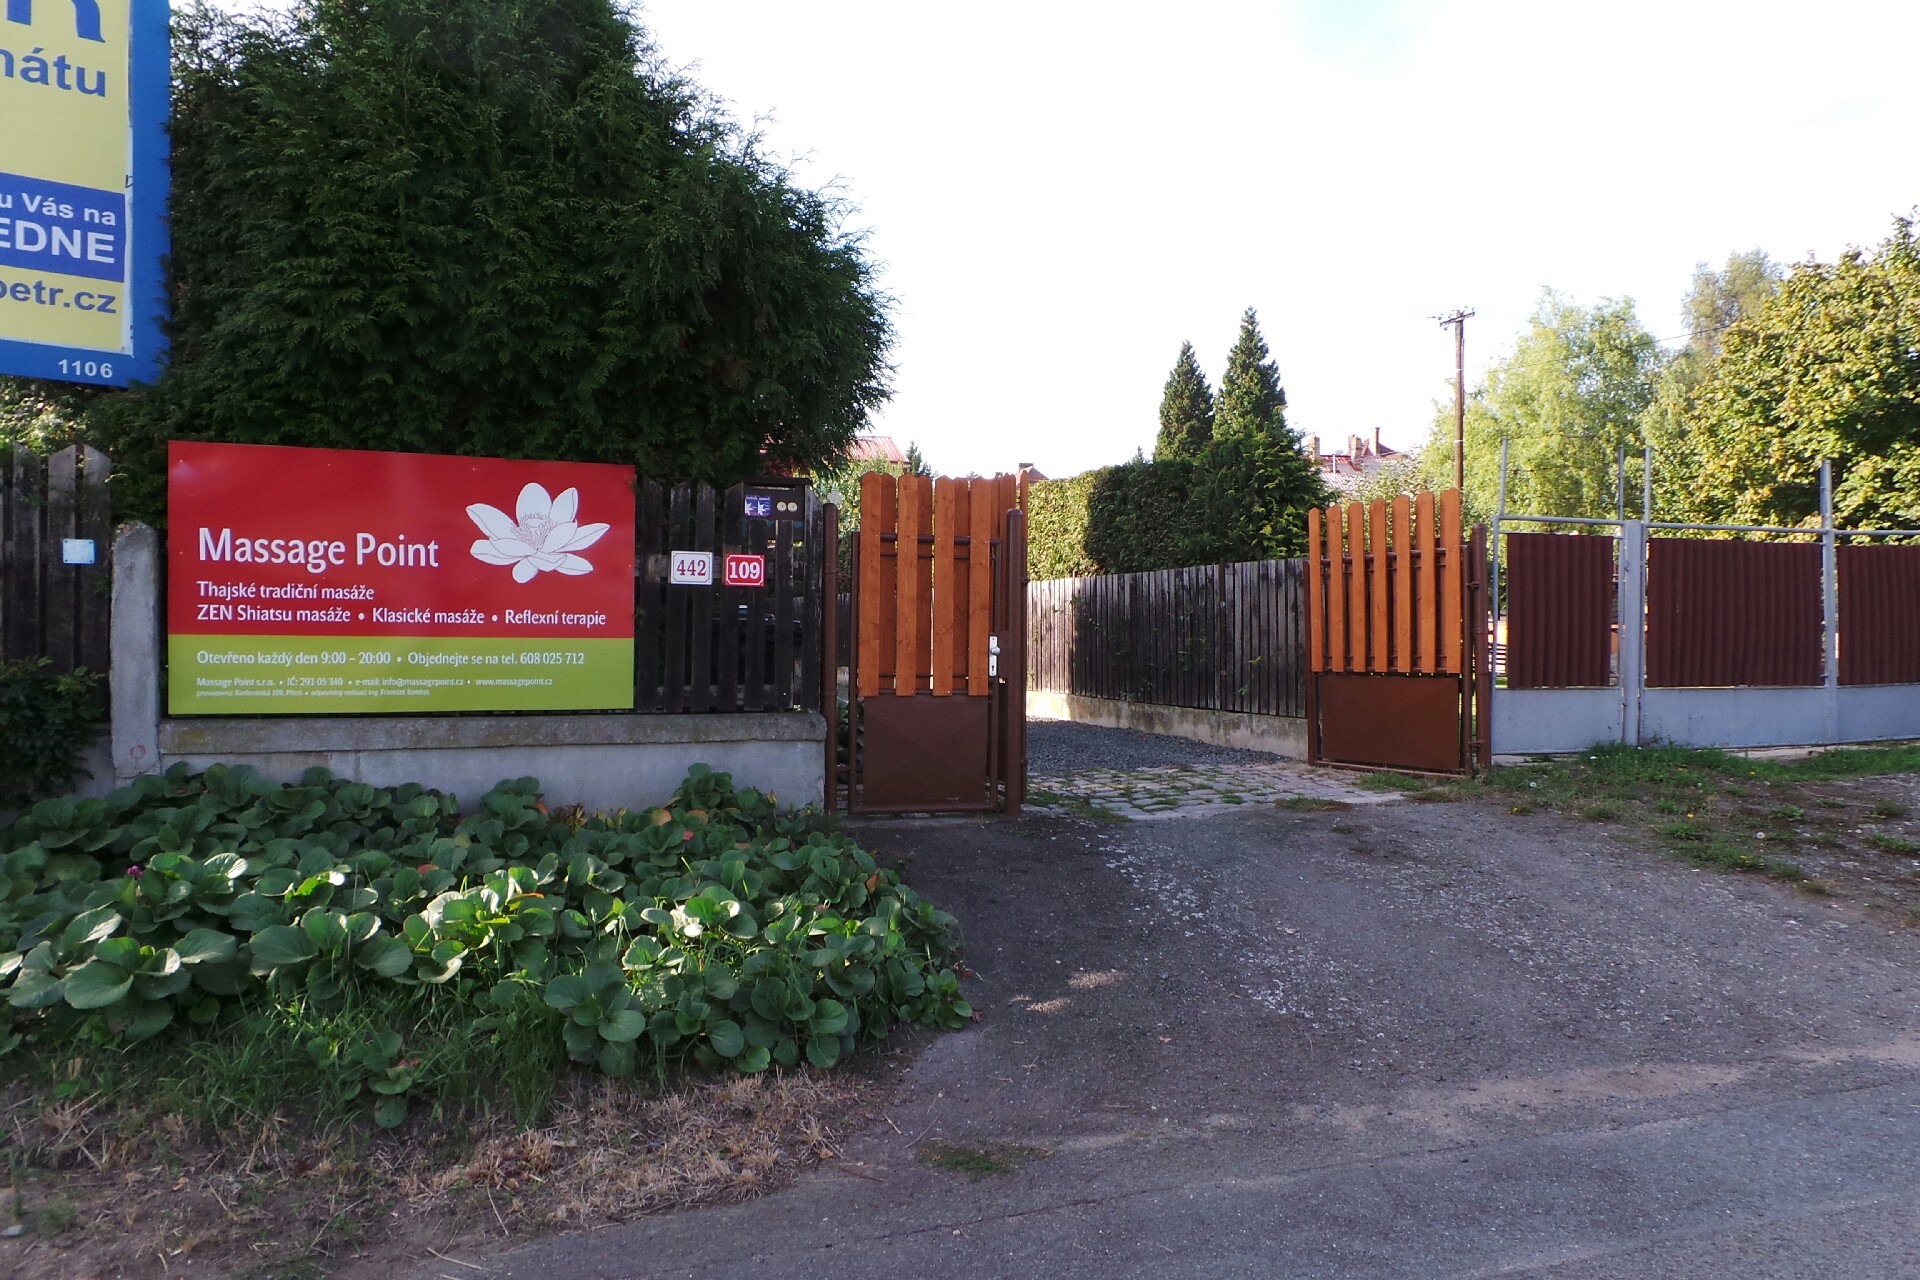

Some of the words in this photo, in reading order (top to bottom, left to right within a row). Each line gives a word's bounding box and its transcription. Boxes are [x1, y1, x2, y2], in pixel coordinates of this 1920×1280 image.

[21, 192, 74, 219] Vás
[83, 207, 116, 226] na
[58, 359, 113, 378] 1106
[199, 527, 346, 574] Massage
[356, 532, 439, 568] Point
[677, 560, 707, 576] 442
[729, 561, 761, 579] 109
[196, 581, 256, 601] Thajské
[260, 583, 318, 599] tradiční
[321, 585, 374, 600] masáže
[197, 604, 233, 621] ZEN
[237, 605, 292, 622] Shiatsu
[296, 606, 351, 622] masáže
[372, 607, 431, 624] Klasické
[434, 609, 485, 624] masáže
[505, 609, 558, 625] Reflexní
[561, 610, 606, 628] terapie
[197, 650, 255, 664] Otevřeno
[257, 651, 292, 667] každý
[295, 652, 318, 664] den
[321, 651, 346, 664] 9:00
[358, 651, 391, 664] 20:00
[408, 652, 469, 667] Objednejte
[471, 654, 483, 664] se
[485, 654, 499, 664] na
[501, 652, 518, 664] tel.
[520, 652, 541, 664] 608
[542, 652, 562, 664] 025
[565, 652, 585, 664] 712
[196, 677, 231, 688] Massage
[233, 677, 254, 686] Point
[300, 677, 314, 686] 291
[329, 677, 344, 686] 340
[355, 677, 380, 686] e-mail:
[382, 677, 464, 688] info@massagepoint.cz
[475, 677, 553, 687] www.massagepoint.cz
